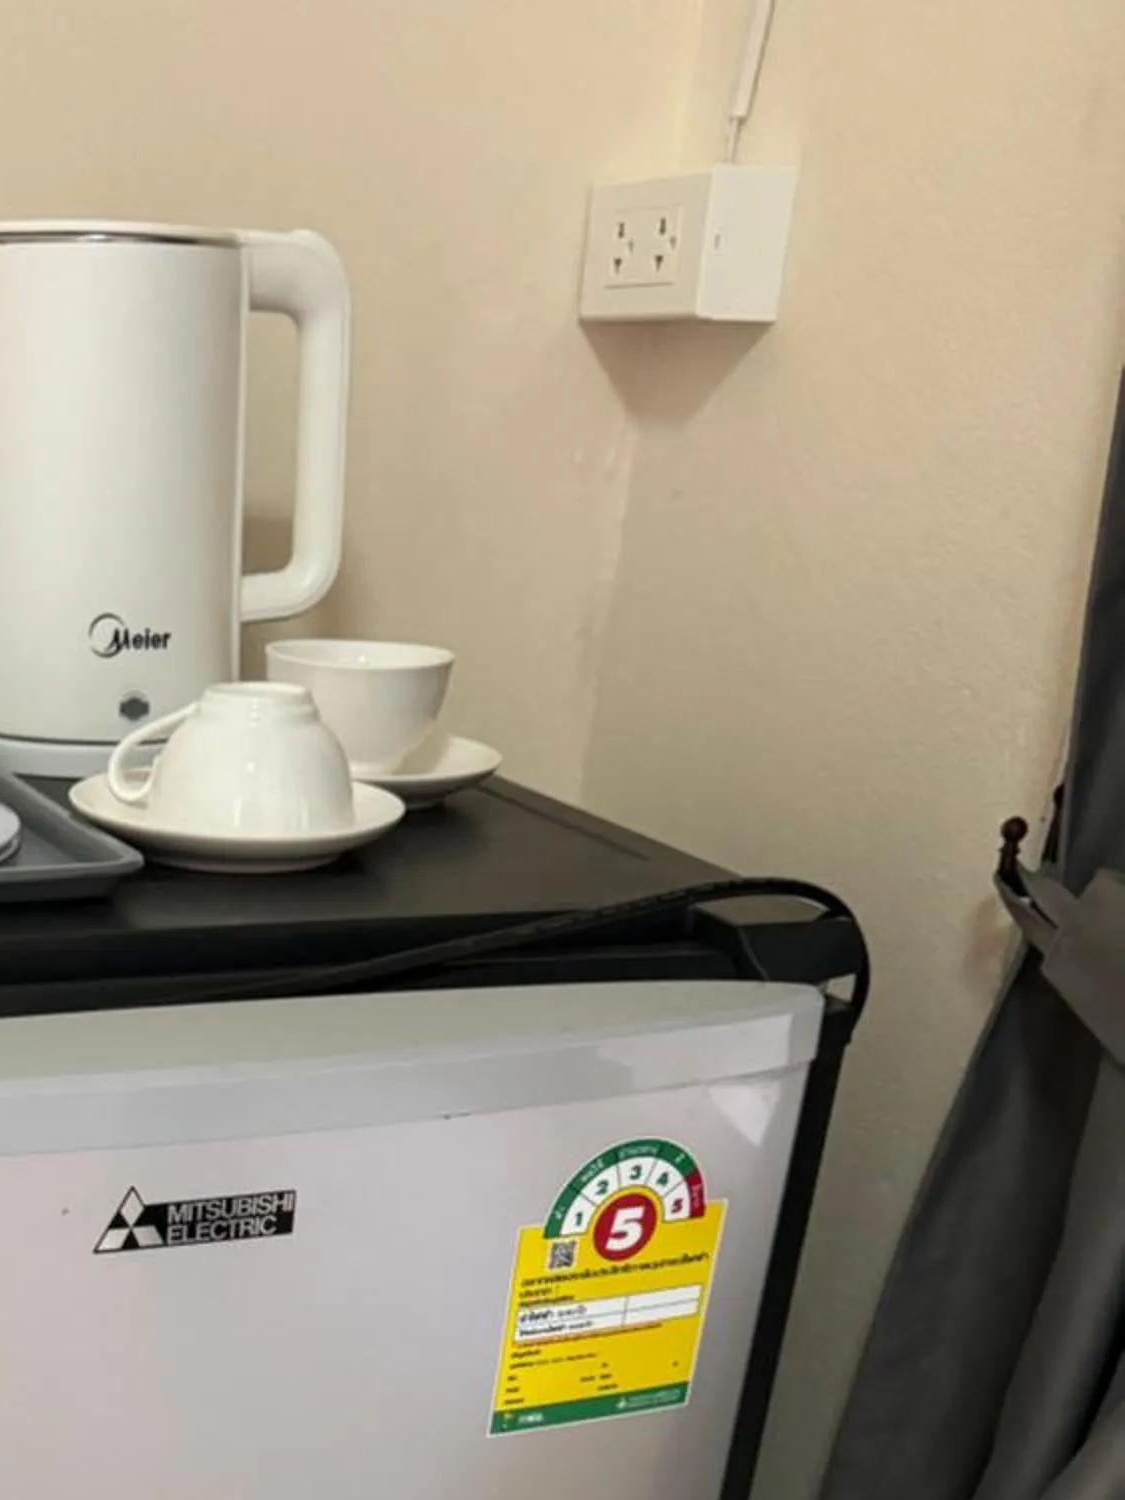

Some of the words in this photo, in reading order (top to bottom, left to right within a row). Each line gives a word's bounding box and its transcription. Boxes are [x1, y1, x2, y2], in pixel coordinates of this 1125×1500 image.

[105, 626, 172, 651] Meier
[167, 1193, 295, 1224] MITSUBISHI
[575, 1211, 584, 1227] 1
[594, 1180, 610, 1196] 2
[629, 1164, 643, 1180] 3
[655, 1171, 669, 1187] 4
[671, 1197, 684, 1214] 5
[167, 1215, 278, 1245] ELECTRIC
[605, 1206, 645, 1252] 5
